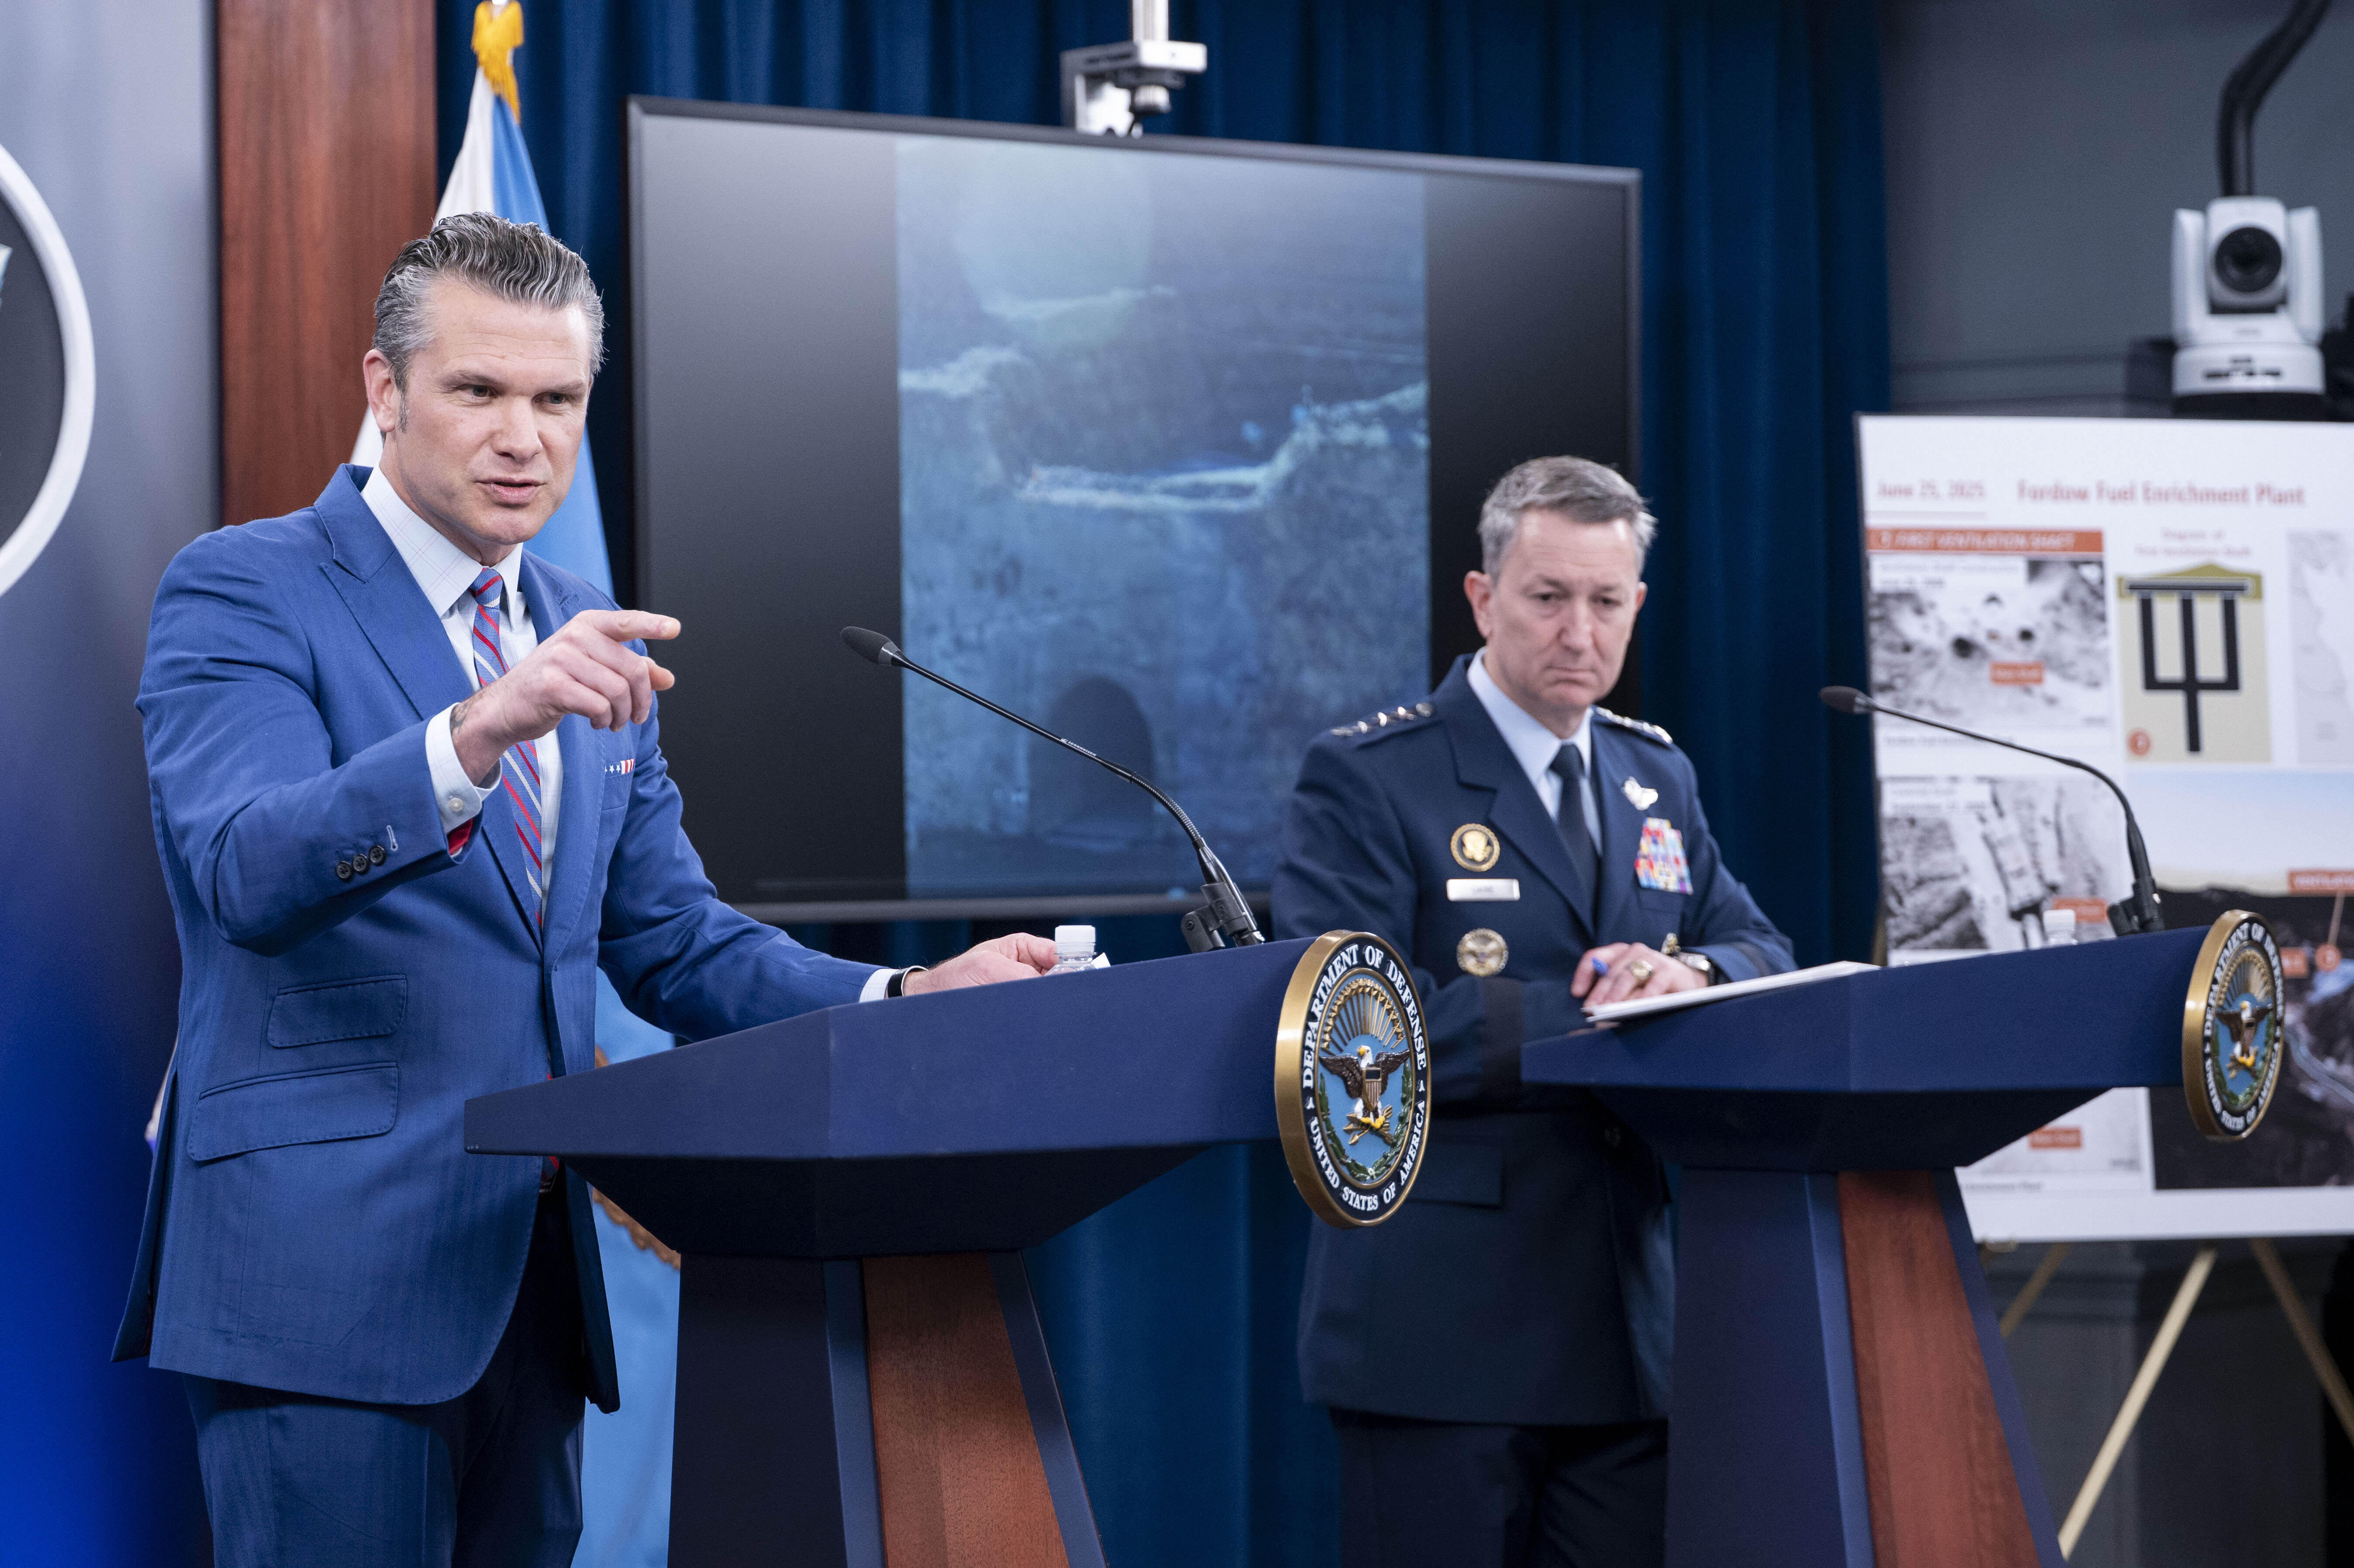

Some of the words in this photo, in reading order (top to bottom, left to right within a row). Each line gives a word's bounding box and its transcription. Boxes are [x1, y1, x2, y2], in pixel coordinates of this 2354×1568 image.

[2017, 480, 2089, 502] Fordow
[2096, 480, 2135, 503] Fuel
[2142, 481, 2249, 503] Enrichment
[2255, 482, 2306, 505] Plant
[1068, 741, 1097, 756] SENNHEISER
[2251, 923, 2265, 942] OF
[1303, 944, 1359, 1089] DEPARTMENT
[1365, 945, 1384, 965] OF
[1388, 960, 1427, 1069] DEFENSE
[2246, 1105, 2257, 1125] OF
[1310, 1116, 1340, 1189] UNITED
[1342, 1186, 1378, 1211] STATES
[1383, 1181, 1396, 1204] OF
[1400, 1100, 1425, 1186] AMERICA
